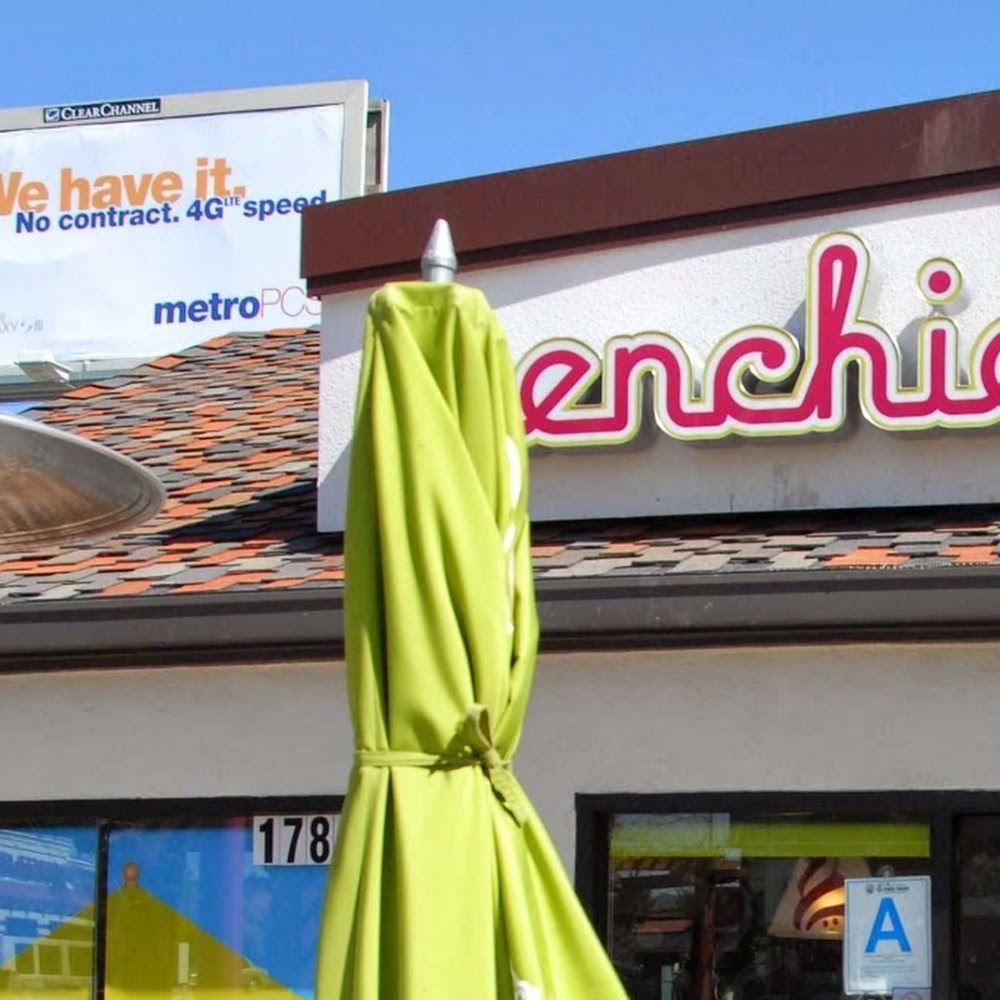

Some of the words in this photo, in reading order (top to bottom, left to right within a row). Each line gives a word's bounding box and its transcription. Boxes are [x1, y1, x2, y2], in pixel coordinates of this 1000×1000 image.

[60, 167, 183, 211] have
[196, 157, 246, 200] it.
[15, 211, 50, 233] No
[59, 203, 180, 231] contract.
[259, 816, 331, 864] 178
[865, 897, 911, 953] A
